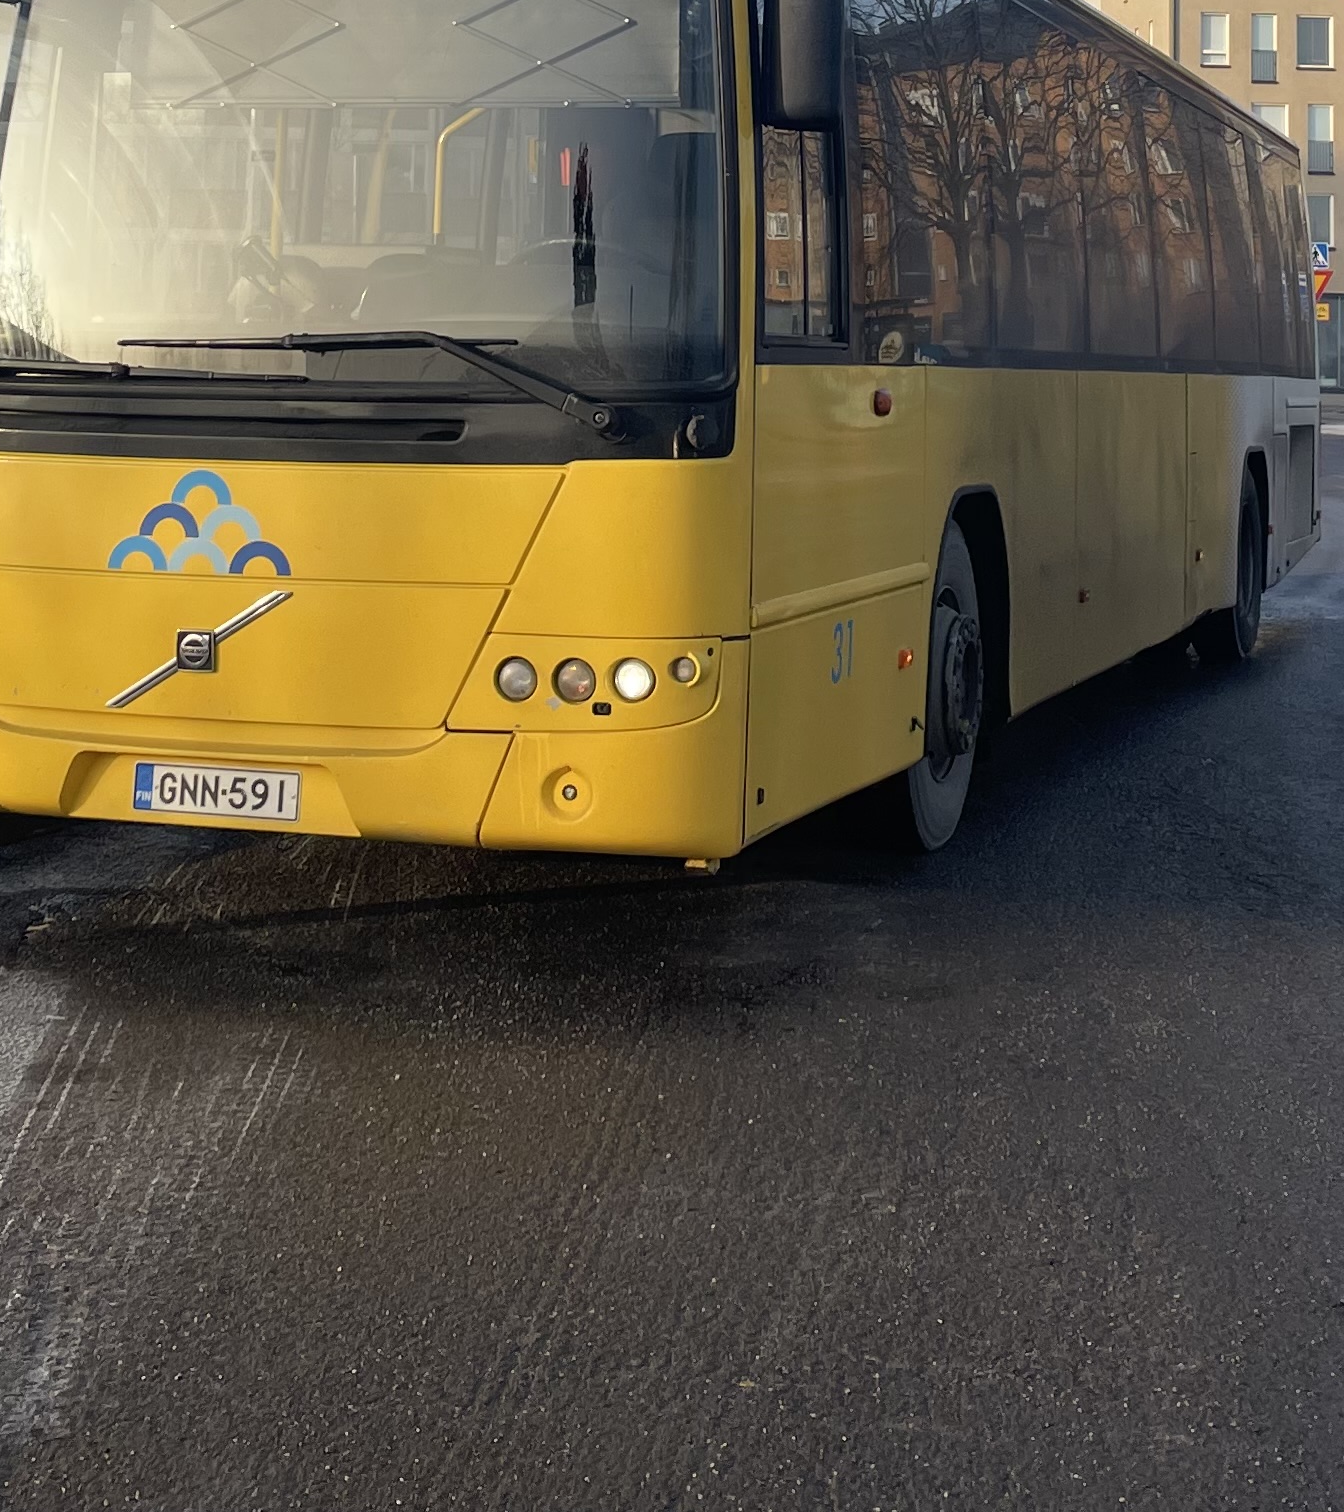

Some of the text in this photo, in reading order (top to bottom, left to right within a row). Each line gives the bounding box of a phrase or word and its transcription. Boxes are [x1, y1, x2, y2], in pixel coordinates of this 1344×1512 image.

[831, 619, 854, 684] 31
[135, 772, 285, 813] FIN GNN-591
